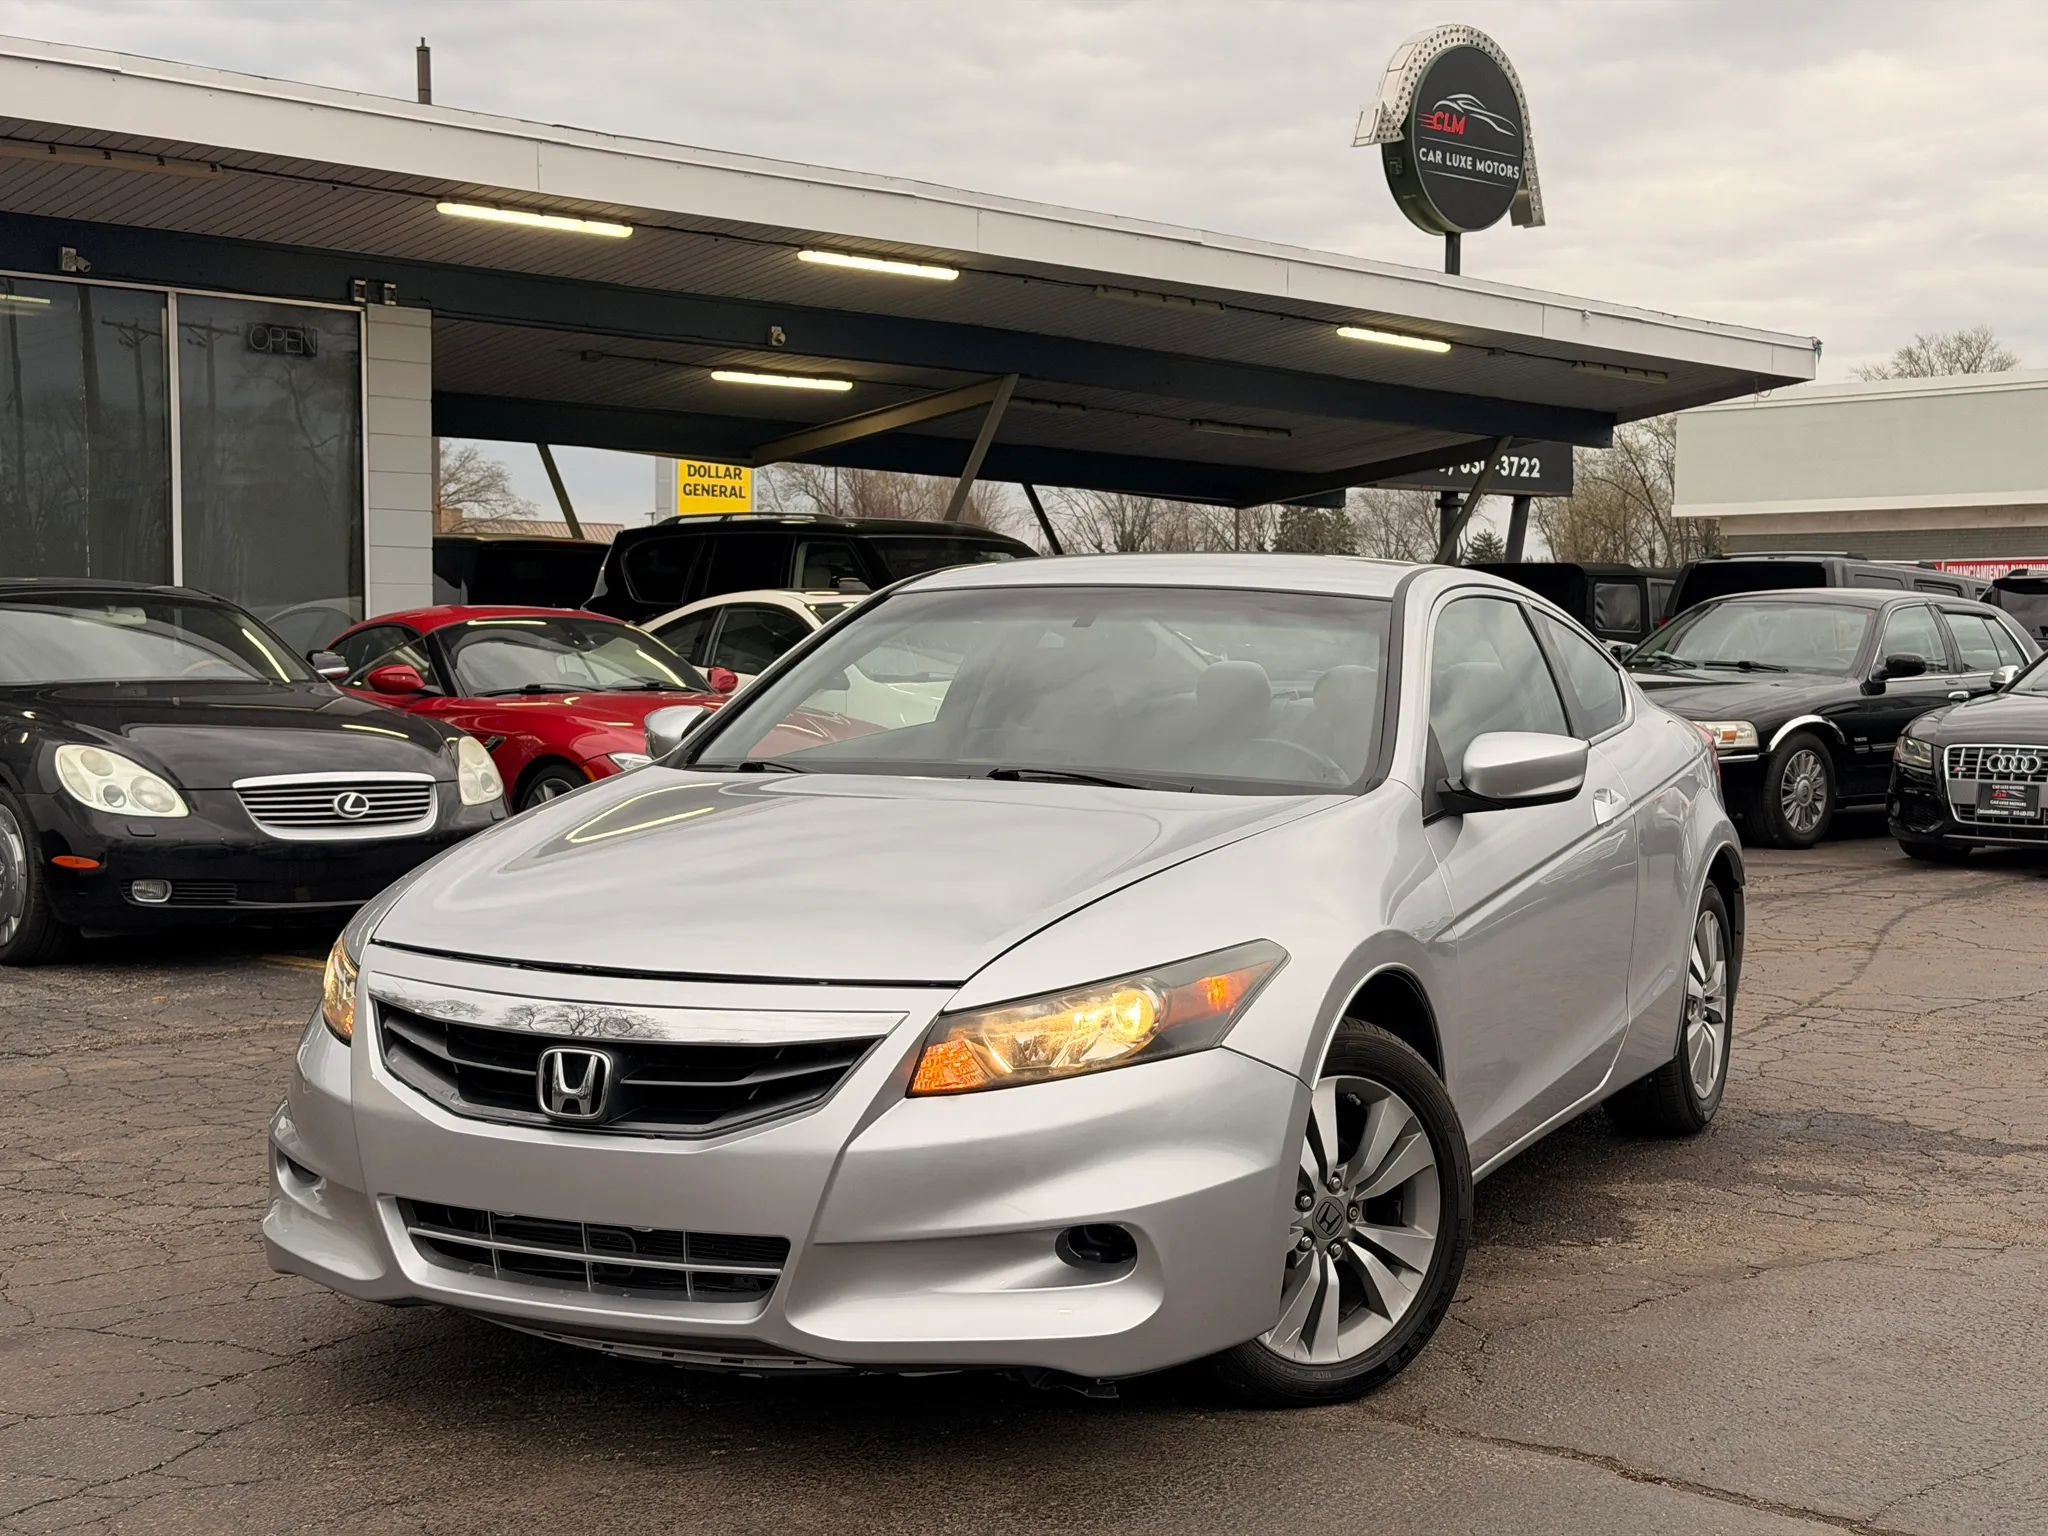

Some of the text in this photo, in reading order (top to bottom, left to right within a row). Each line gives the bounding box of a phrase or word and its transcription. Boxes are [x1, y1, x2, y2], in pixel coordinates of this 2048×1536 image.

[1431, 111, 1467, 136] CLM
[1419, 147, 1520, 180] CAR LUXE MOTORS
[249, 325, 319, 357] OPEN
[687, 463, 743, 480] DOLLAR
[682, 482, 746, 499] GENERAL
